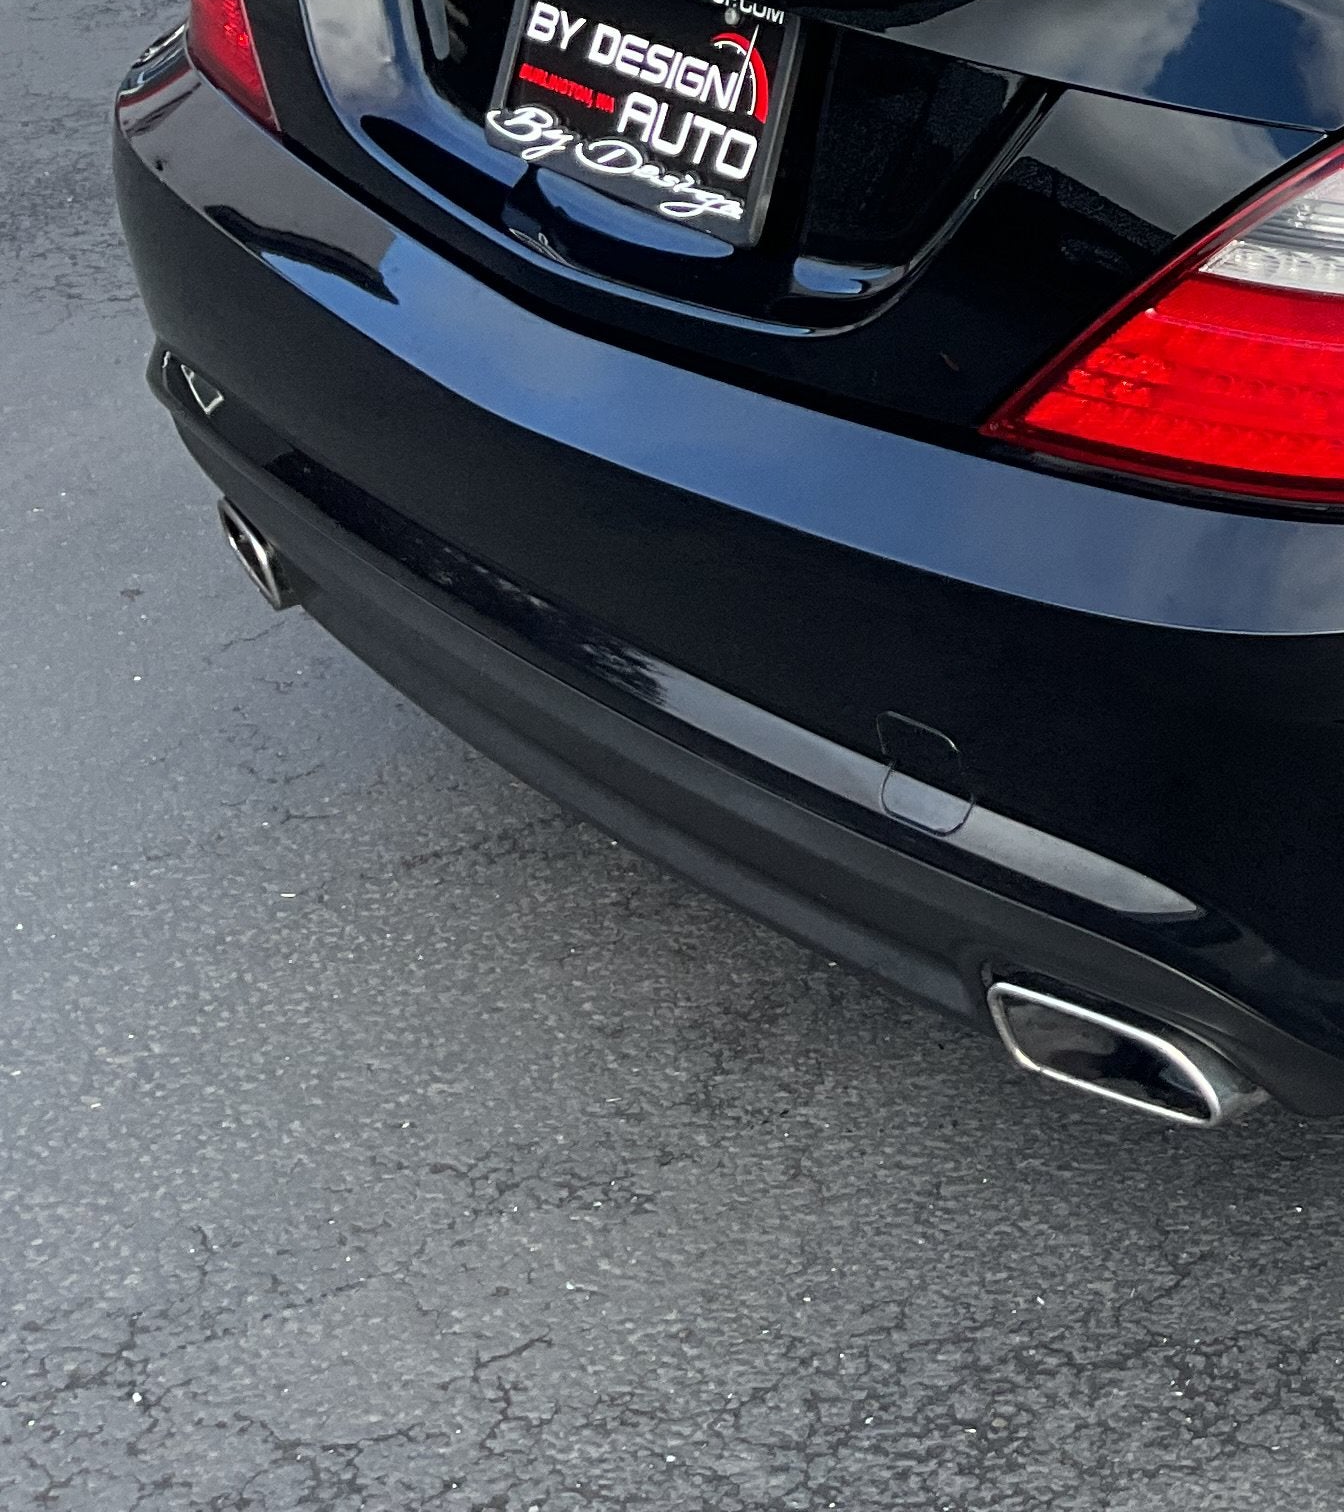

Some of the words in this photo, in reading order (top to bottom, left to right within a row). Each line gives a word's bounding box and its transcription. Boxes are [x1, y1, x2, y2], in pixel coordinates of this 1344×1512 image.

[526, 0, 587, 50] BY
[588, 22, 741, 113] DESIGN
[485, 106, 574, 161] By
[617, 91, 757, 180] AUTO
